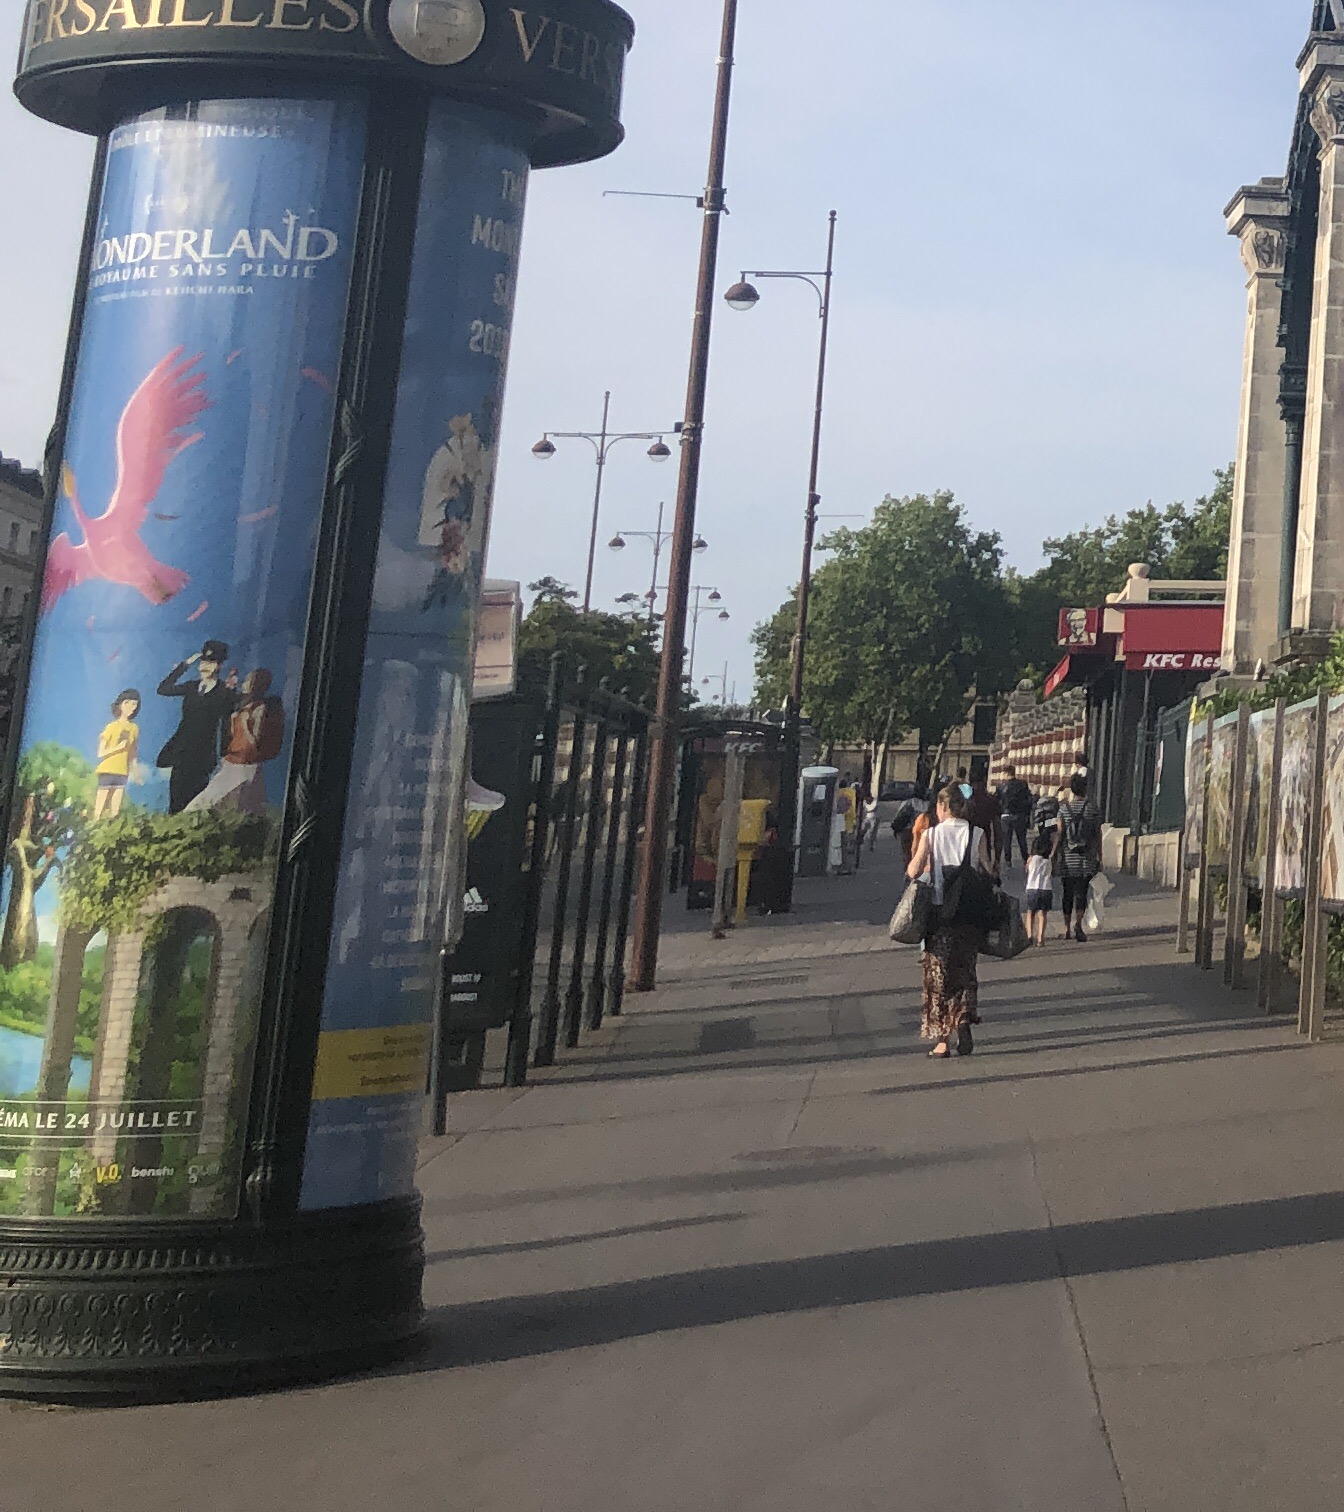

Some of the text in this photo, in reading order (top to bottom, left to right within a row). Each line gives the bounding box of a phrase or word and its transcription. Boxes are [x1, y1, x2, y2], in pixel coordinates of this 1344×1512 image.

[168, 263, 227, 278] SANS
[240, 263, 316, 279] PLUIE
[1143, 653, 1185, 668] KFC
[35, 1112, 59, 1129] LE
[64, 1112, 90, 1129] 24
[98, 1110, 197, 1131] JUILLET
